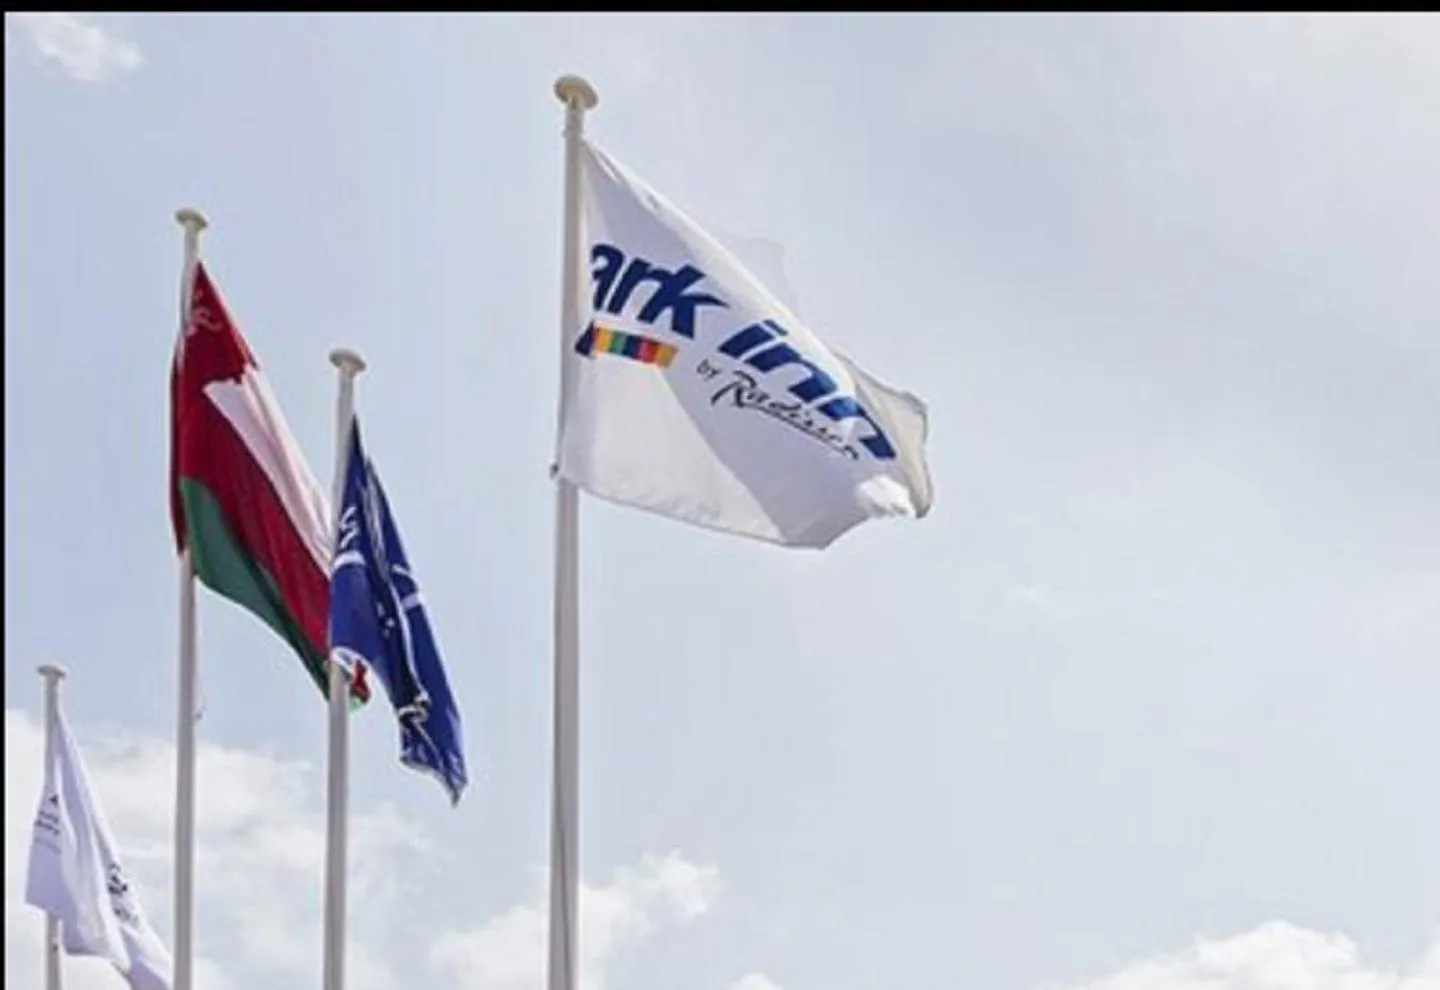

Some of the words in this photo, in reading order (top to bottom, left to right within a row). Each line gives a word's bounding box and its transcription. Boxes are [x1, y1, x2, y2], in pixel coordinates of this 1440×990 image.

[697, 359, 717, 380] by
[710, 370, 860, 461] Radisson
[716, 319, 896, 461] inn
